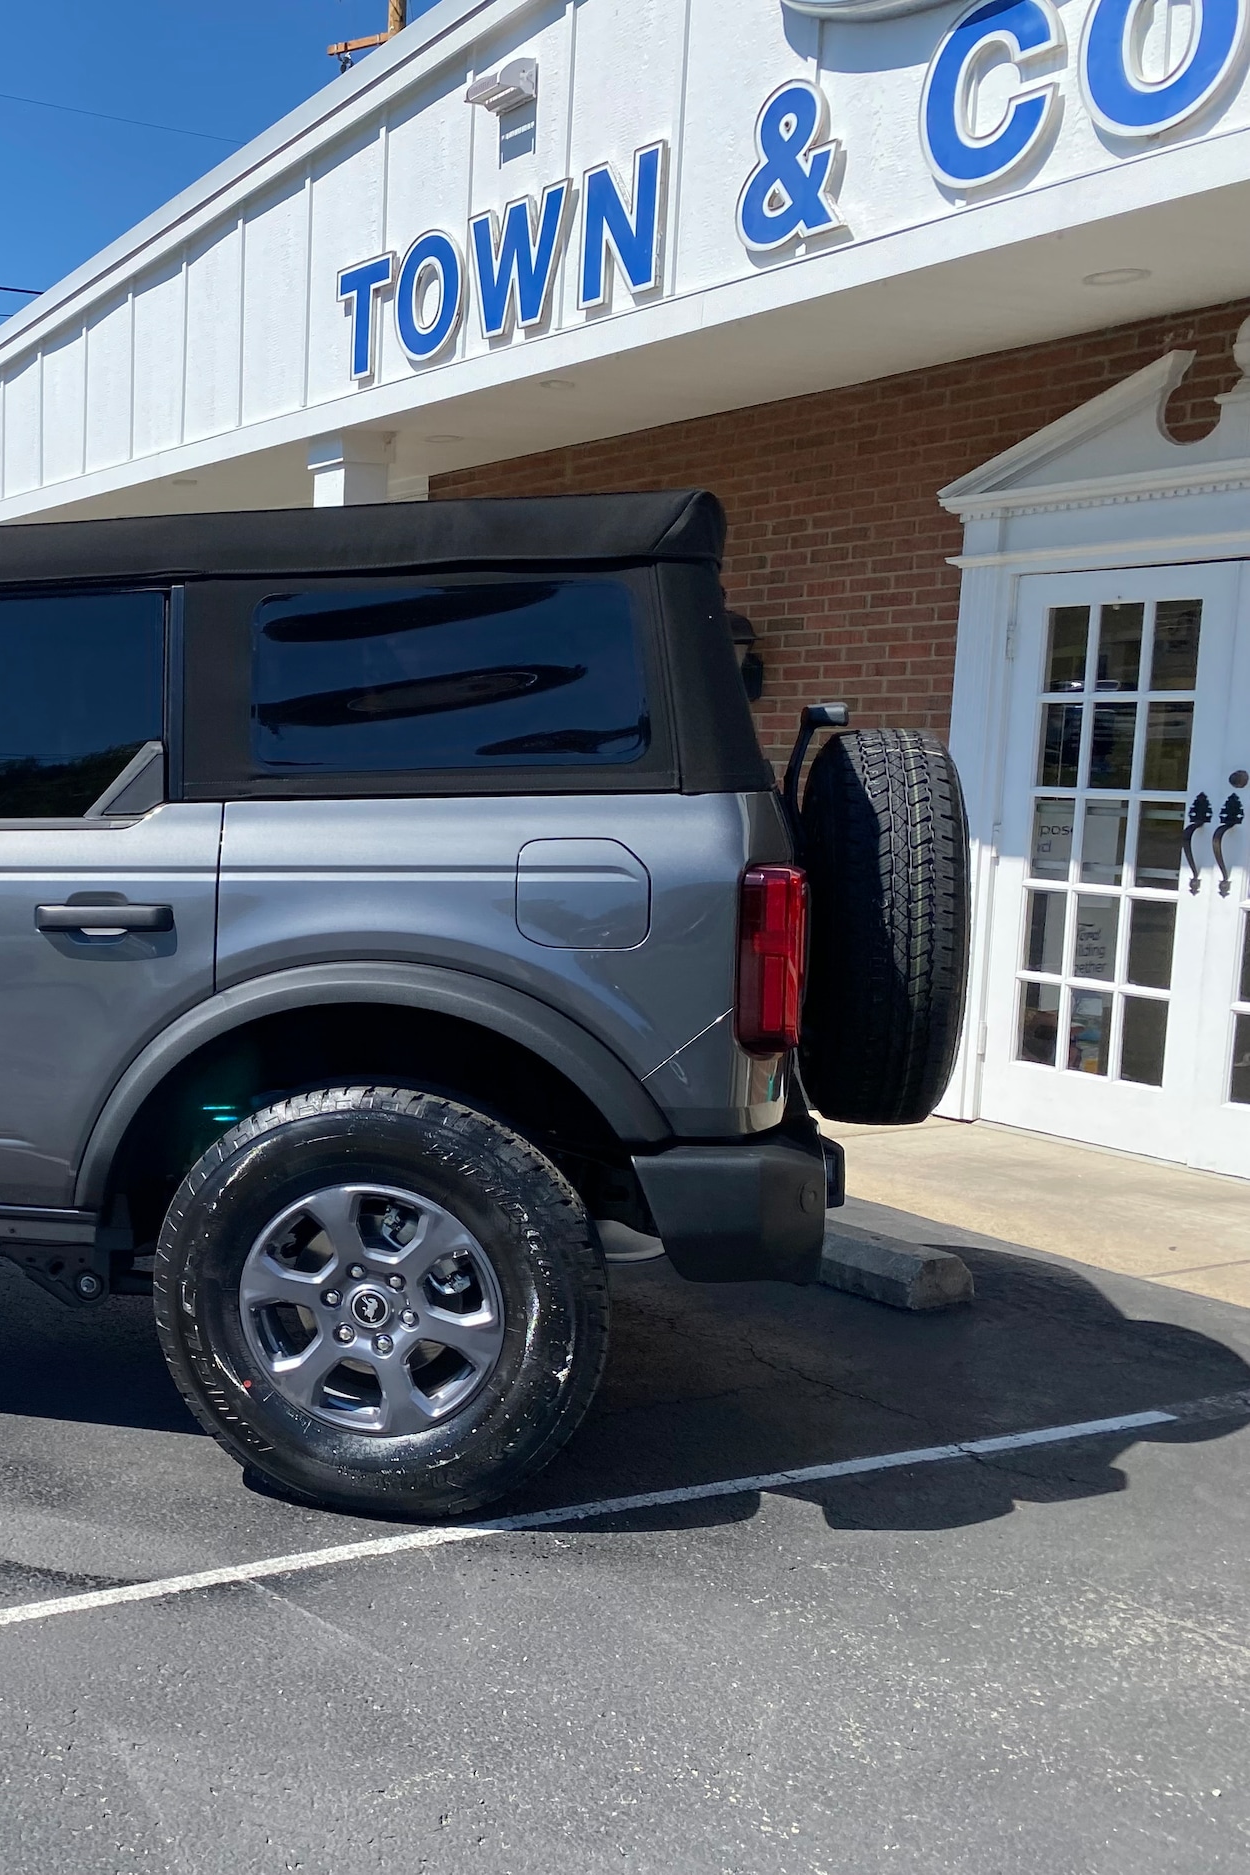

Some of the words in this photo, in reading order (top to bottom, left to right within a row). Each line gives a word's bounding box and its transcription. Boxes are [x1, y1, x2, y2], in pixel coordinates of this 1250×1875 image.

[336, 138, 668, 381] TOWN
[735, 79, 848, 252] &
[918, 0, 1246, 190] CO
